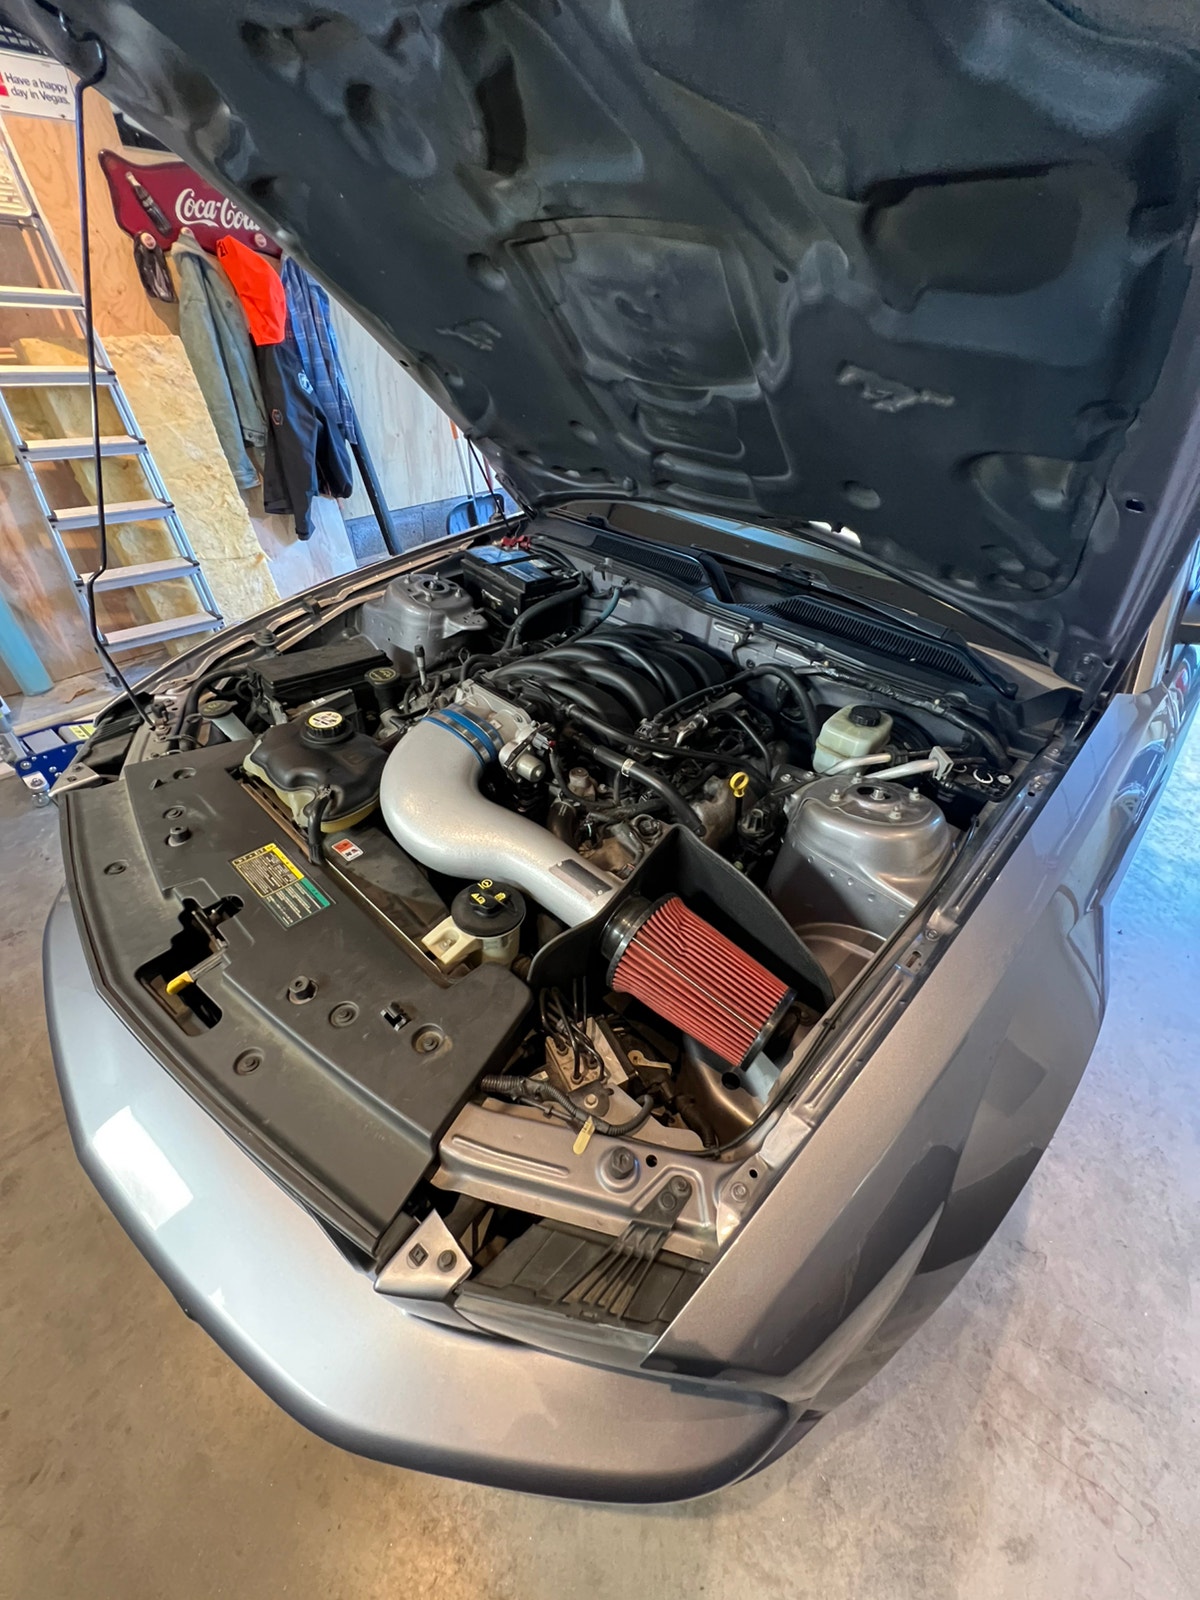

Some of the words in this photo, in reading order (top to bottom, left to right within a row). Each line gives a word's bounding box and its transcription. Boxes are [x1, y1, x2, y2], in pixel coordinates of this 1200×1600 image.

[4, 72, 31, 86] Have
[32, 79, 39, 88] a
[38, 78, 68, 95] happy
[10, 86, 28, 100] day
[28, 88, 40, 100] in
[38, 90, 71, 105] Vegas.
